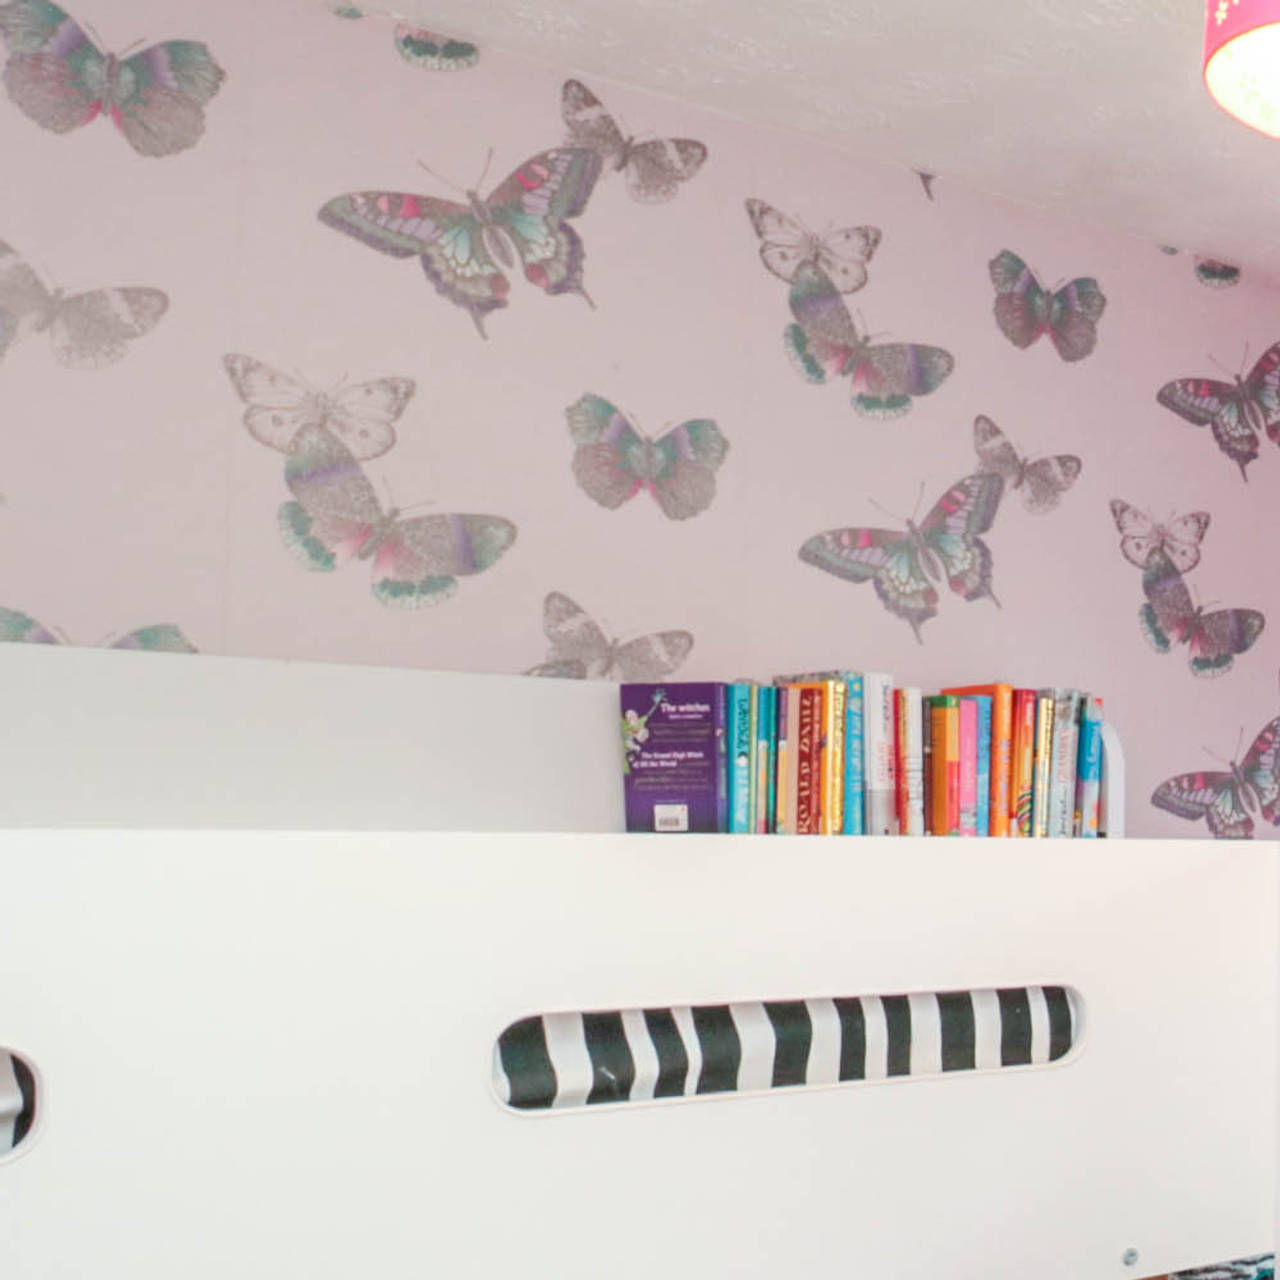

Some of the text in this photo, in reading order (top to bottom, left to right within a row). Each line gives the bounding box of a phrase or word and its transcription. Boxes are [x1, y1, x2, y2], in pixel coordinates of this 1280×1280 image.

[661, 703, 677, 713] The
[798, 698, 811, 835] ROALD DAHL
